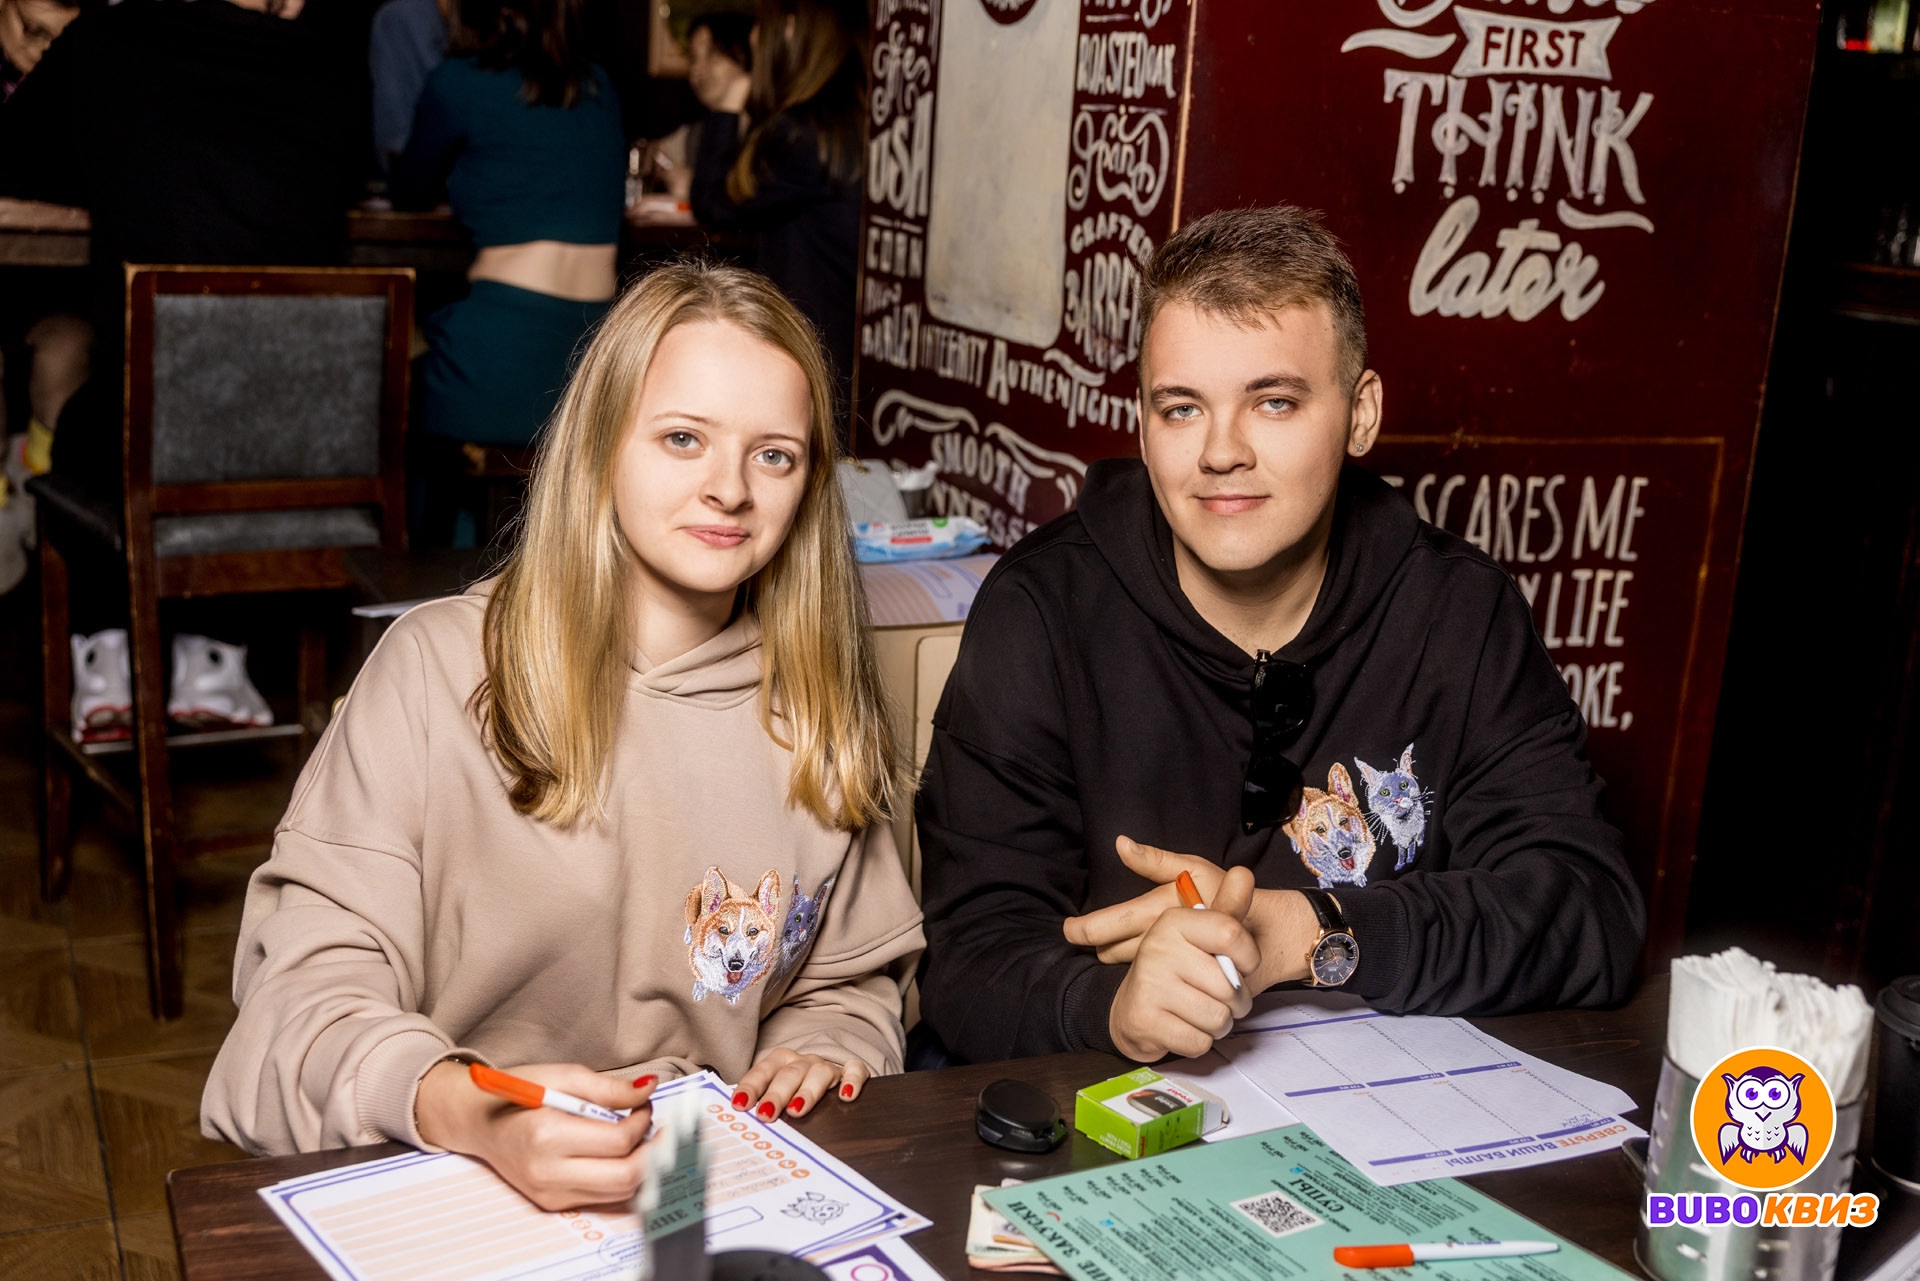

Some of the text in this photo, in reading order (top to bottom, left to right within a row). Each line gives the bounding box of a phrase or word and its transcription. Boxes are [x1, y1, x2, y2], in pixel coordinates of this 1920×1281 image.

[1077, 31, 1148, 98] ROASTED
[1481, 26, 1584, 68] FIRST
[868, 91, 933, 219] USA
[1383, 68, 1655, 204] THINK
[1408, 195, 1605, 322] later
[931, 432, 1031, 515] SMOOTH
[1571, 474, 1649, 562] ME
[1543, 568, 1635, 650] LIFE
[1556, 661, 1635, 732] OKE,
[1444, 1124, 1628, 1168] СВЕРЬТЕ ВАШИ БАЛЛЫ
[1007, 1200, 1081, 1258] ЗАКУСКИ
[1289, 1178, 1345, 1213] СУПЫ
